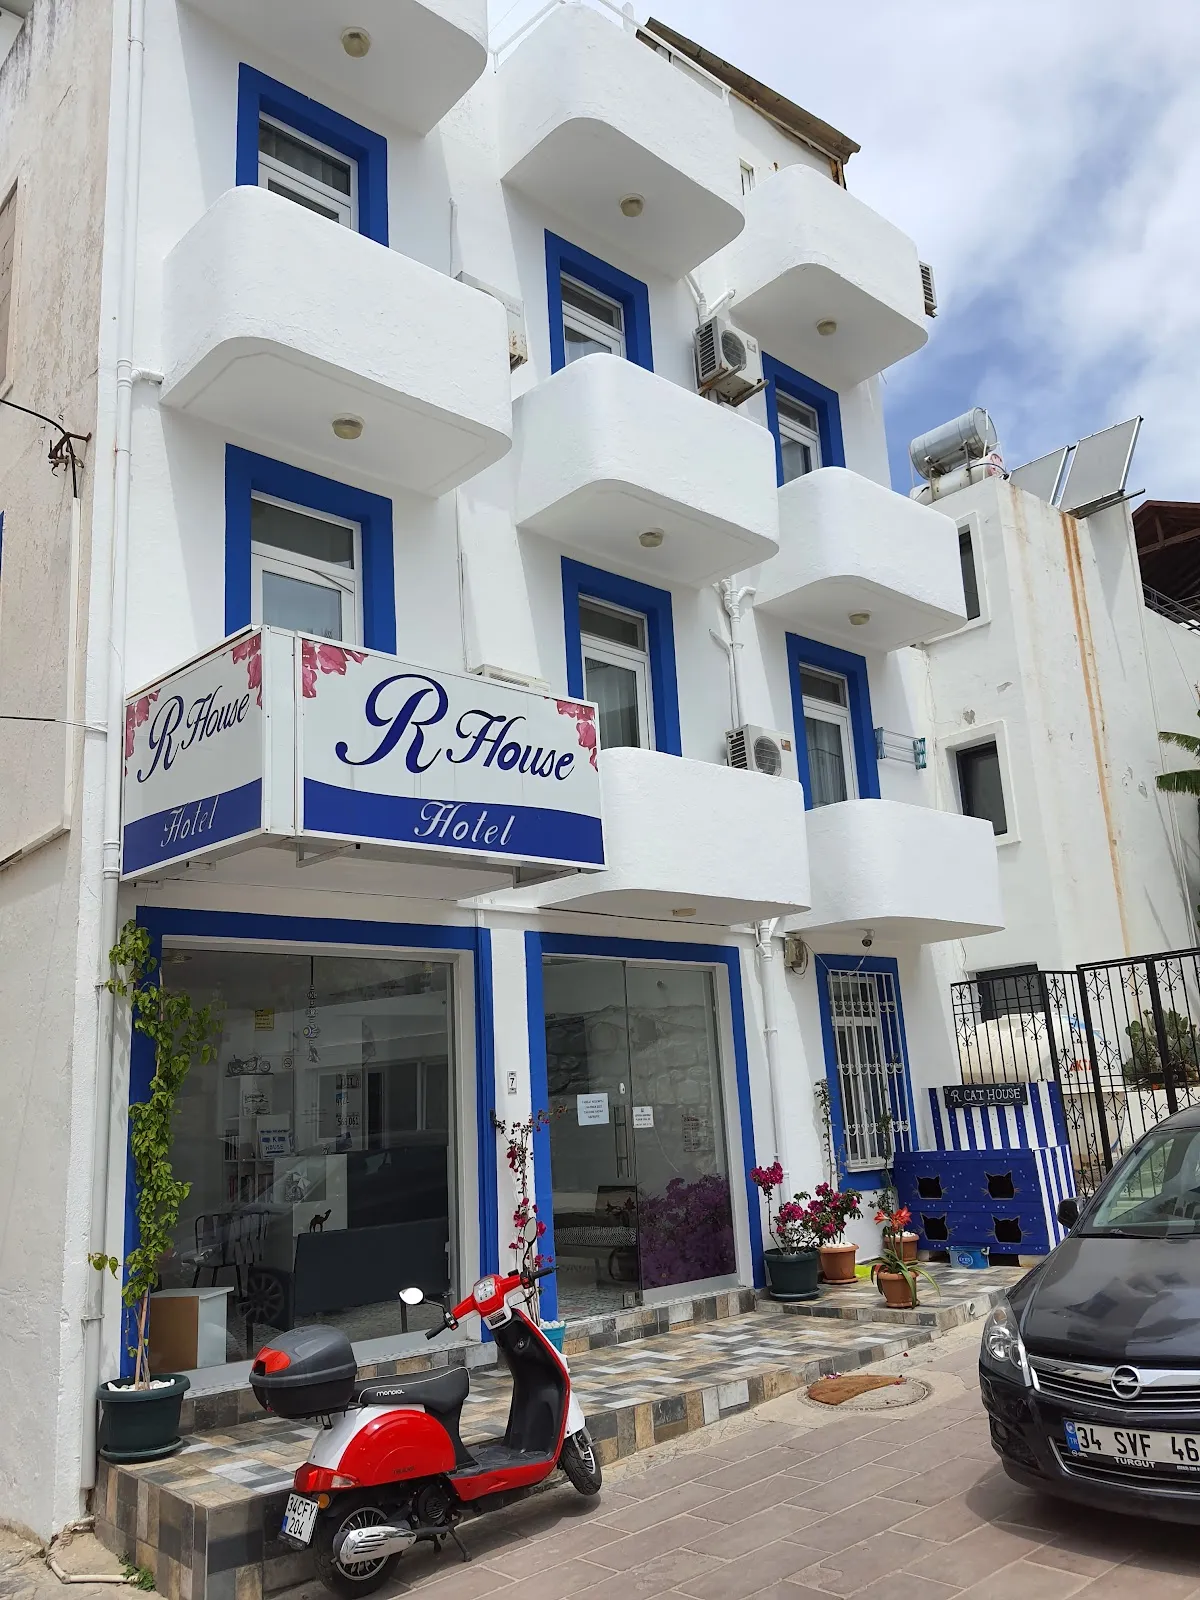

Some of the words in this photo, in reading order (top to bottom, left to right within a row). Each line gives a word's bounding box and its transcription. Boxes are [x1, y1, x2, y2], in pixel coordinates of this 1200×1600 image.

[137, 695, 185, 784] R
[180, 685, 250, 750] House
[335, 673, 449, 774] R
[445, 709, 575, 781] House
[160, 795, 219, 848] Hotel
[413, 800, 515, 846] Hotel
[509, 1077, 515, 1087] 7
[950, 1089, 962, 1103] R
[963, 1089, 984, 1101] CAT
[986, 1087, 1021, 1100] HOUSE
[1077, 1426, 1102, 1450] 34
[1113, 1431, 1151, 1458] SVF
[1170, 1436, 1200, 1462] 46
[1113, 1456, 1156, 1469] TURGUT
[288, 1496, 316, 1521] 34CFY
[289, 1516, 305, 1537] 204
